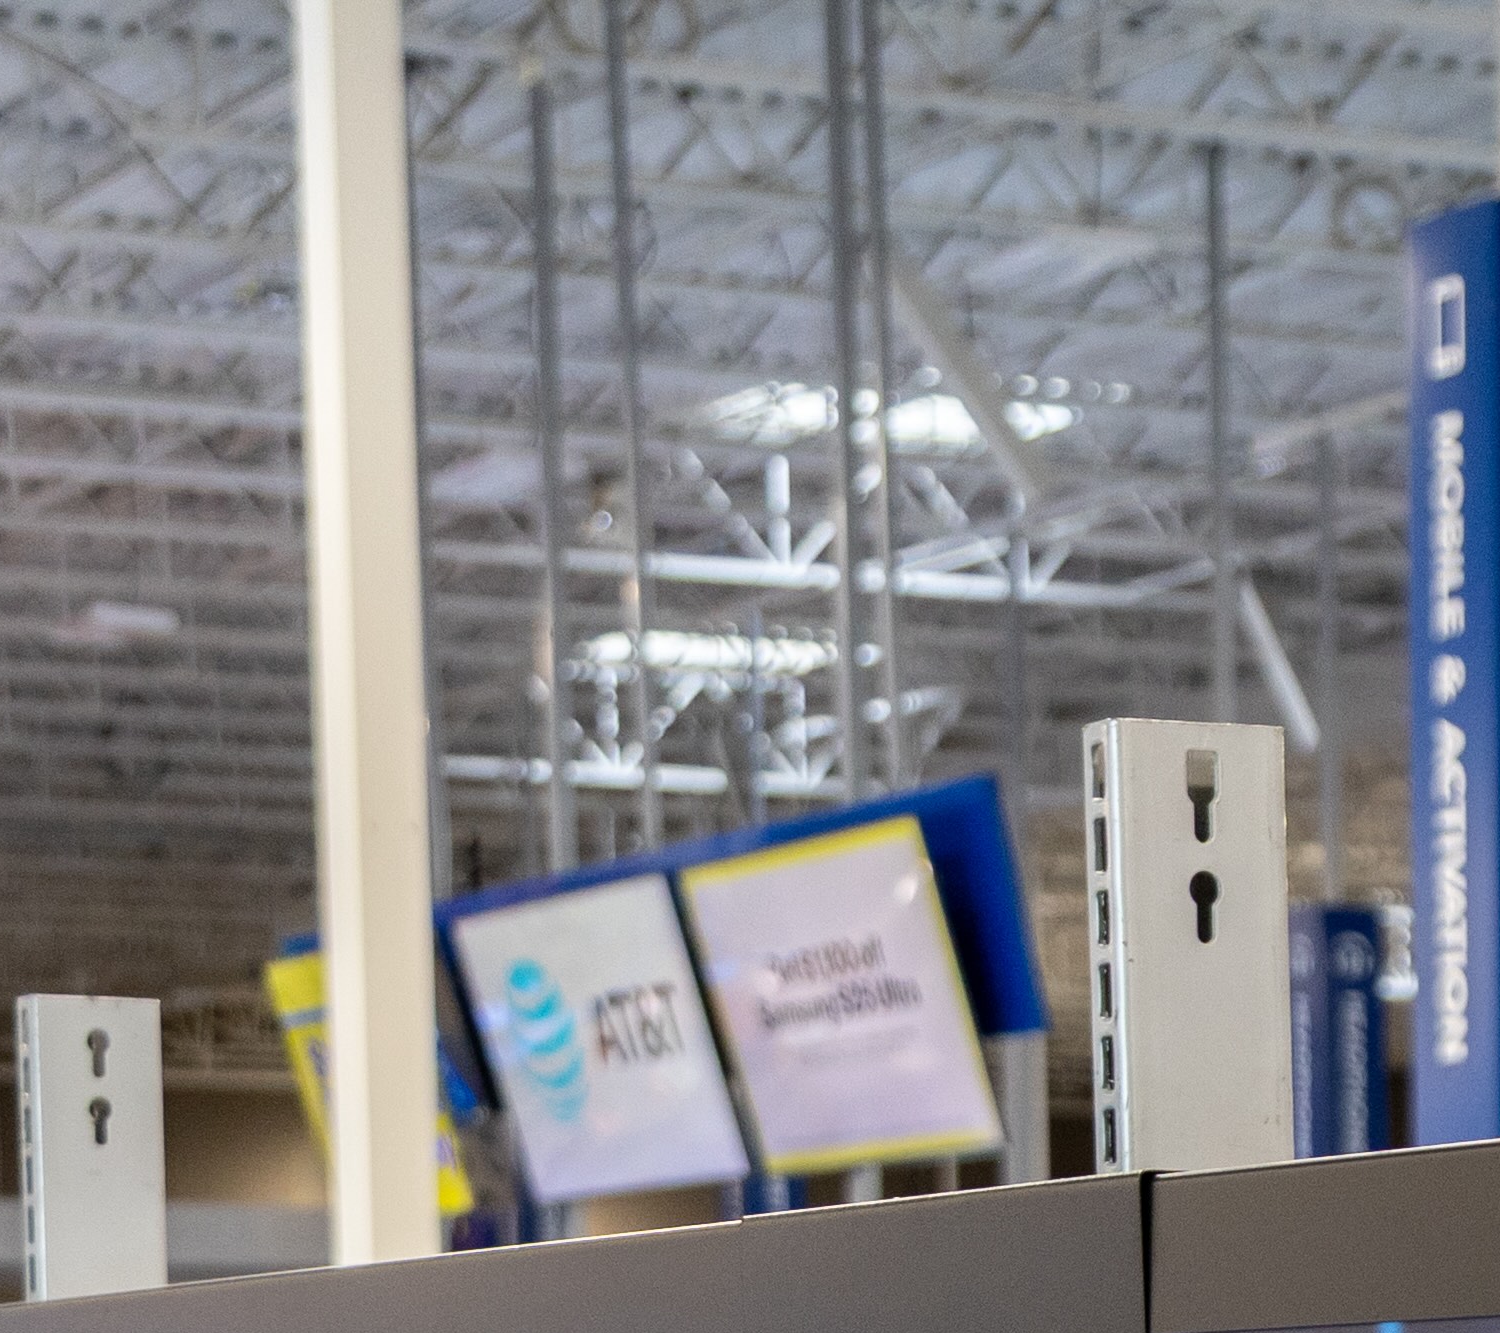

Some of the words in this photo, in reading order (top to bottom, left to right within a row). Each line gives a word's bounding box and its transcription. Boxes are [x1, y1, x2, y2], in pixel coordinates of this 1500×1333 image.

[1432, 407, 1467, 642] MOBILE
[1433, 652, 1468, 703] &
[1433, 718, 1469, 1066] ACTIVATION
[591, 983, 684, 1066] AT&T
